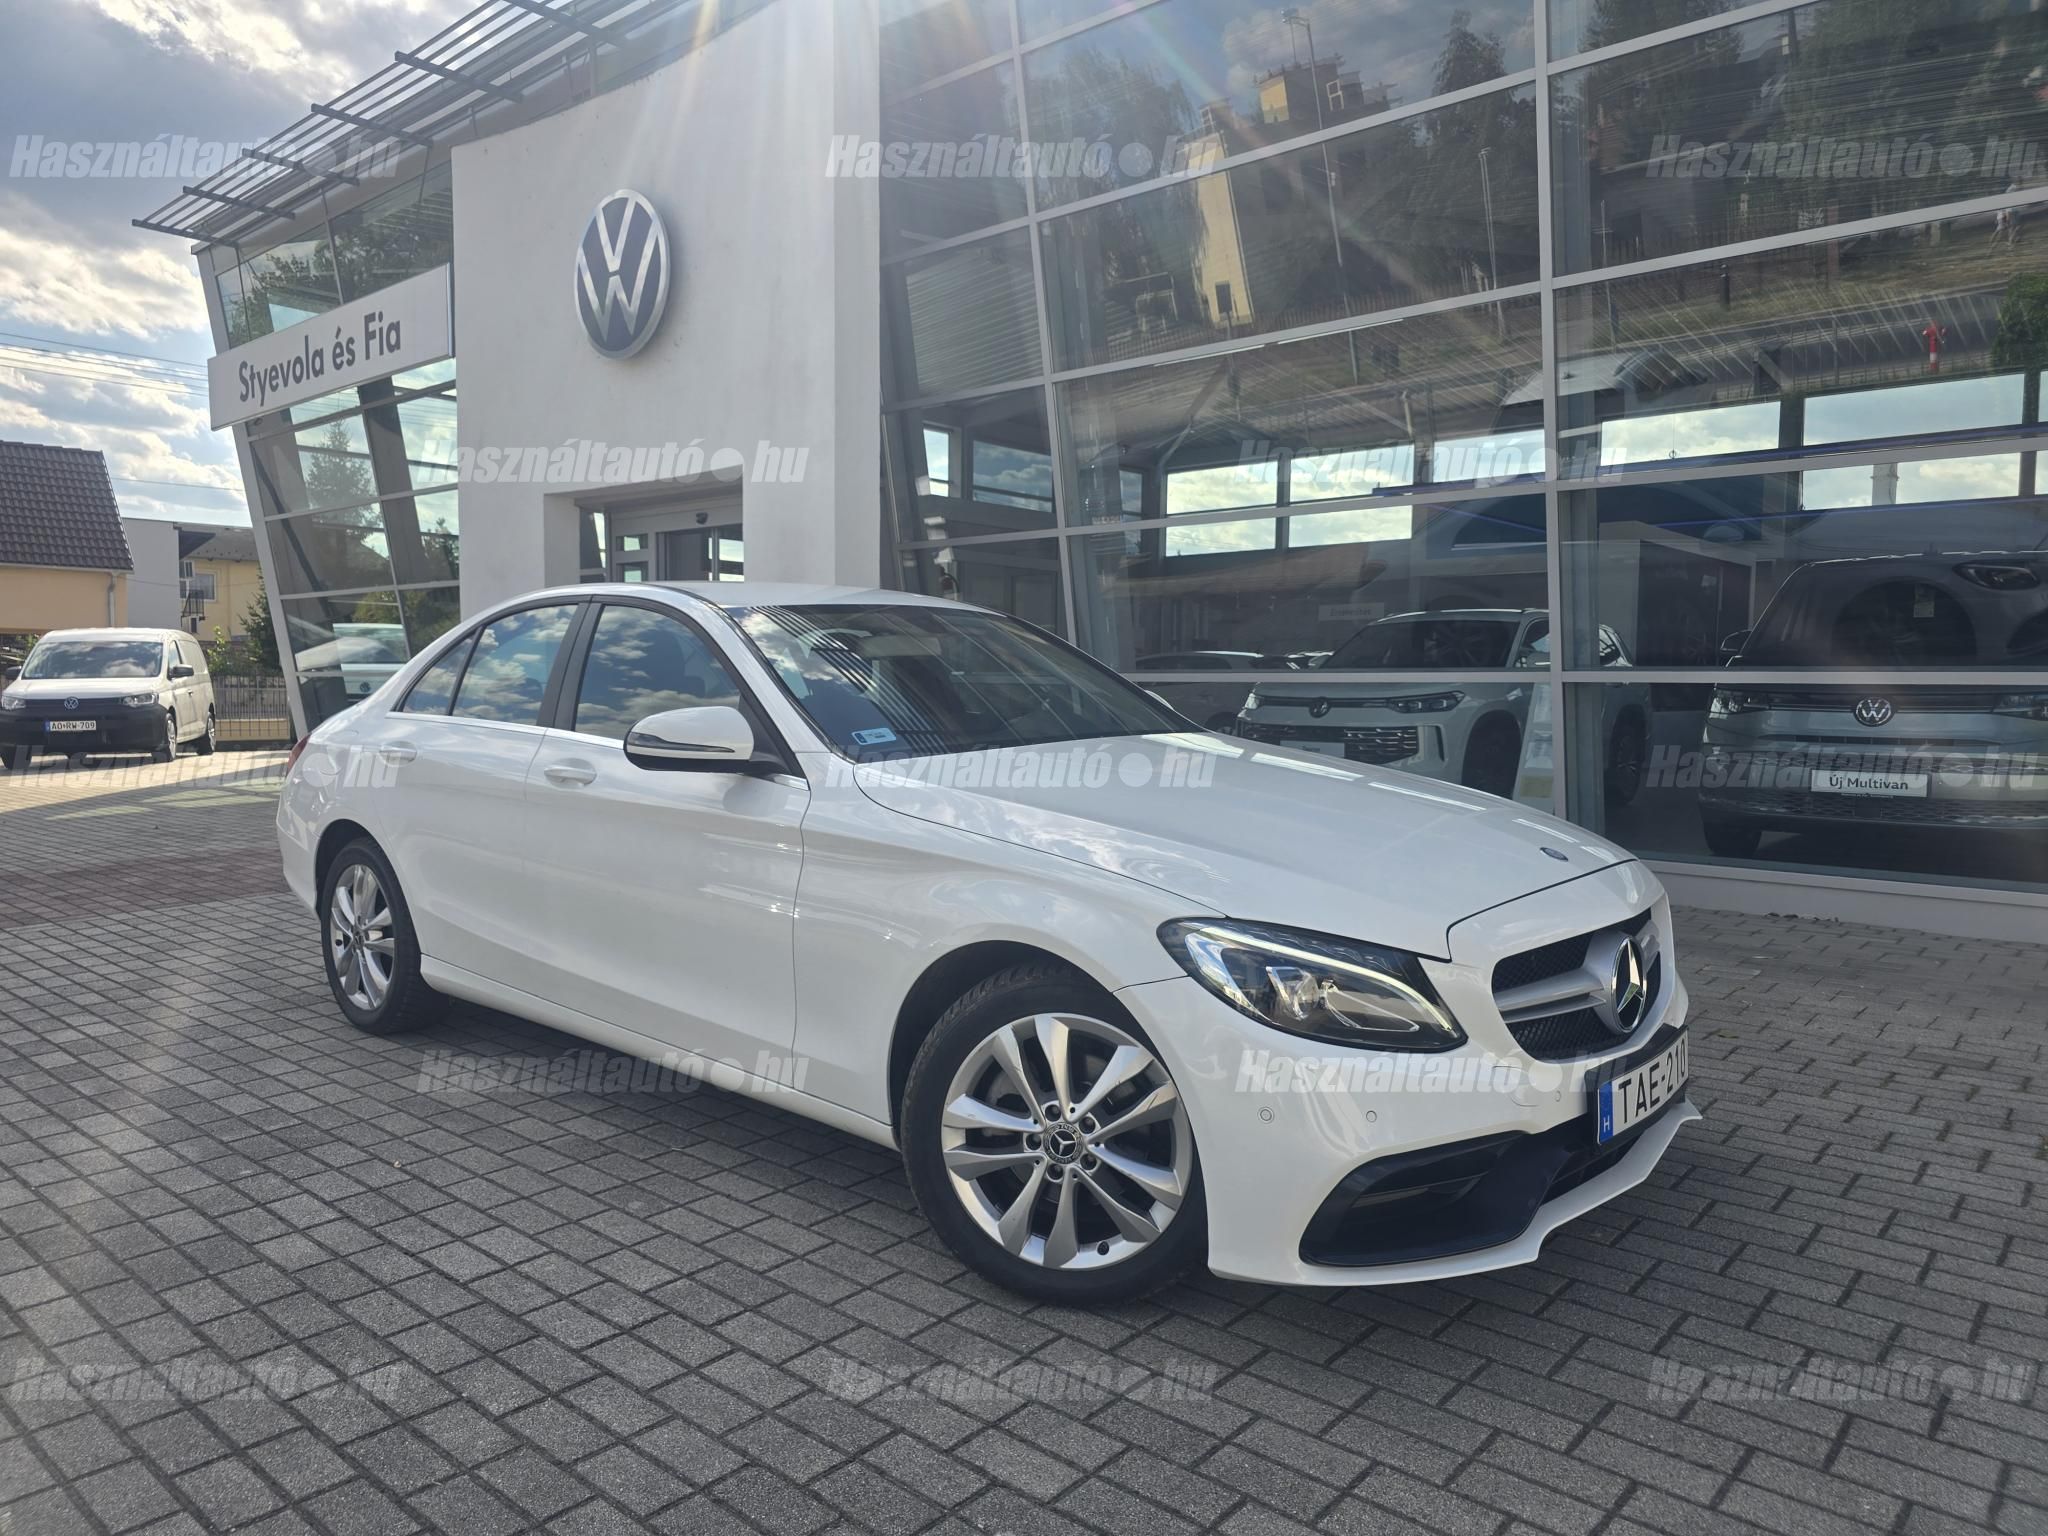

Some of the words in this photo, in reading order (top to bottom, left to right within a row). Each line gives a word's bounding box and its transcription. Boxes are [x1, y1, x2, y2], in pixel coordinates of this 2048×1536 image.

[239, 335, 324, 407] Styevola
[332, 326, 356, 371] és
[364, 311, 401, 360] Fia
[1829, 774, 1843, 789] Új
[1847, 778, 1908, 790] Multivan
[1603, 1116, 1610, 1133] H
[1618, 1038, 1686, 1125] TAE-210
